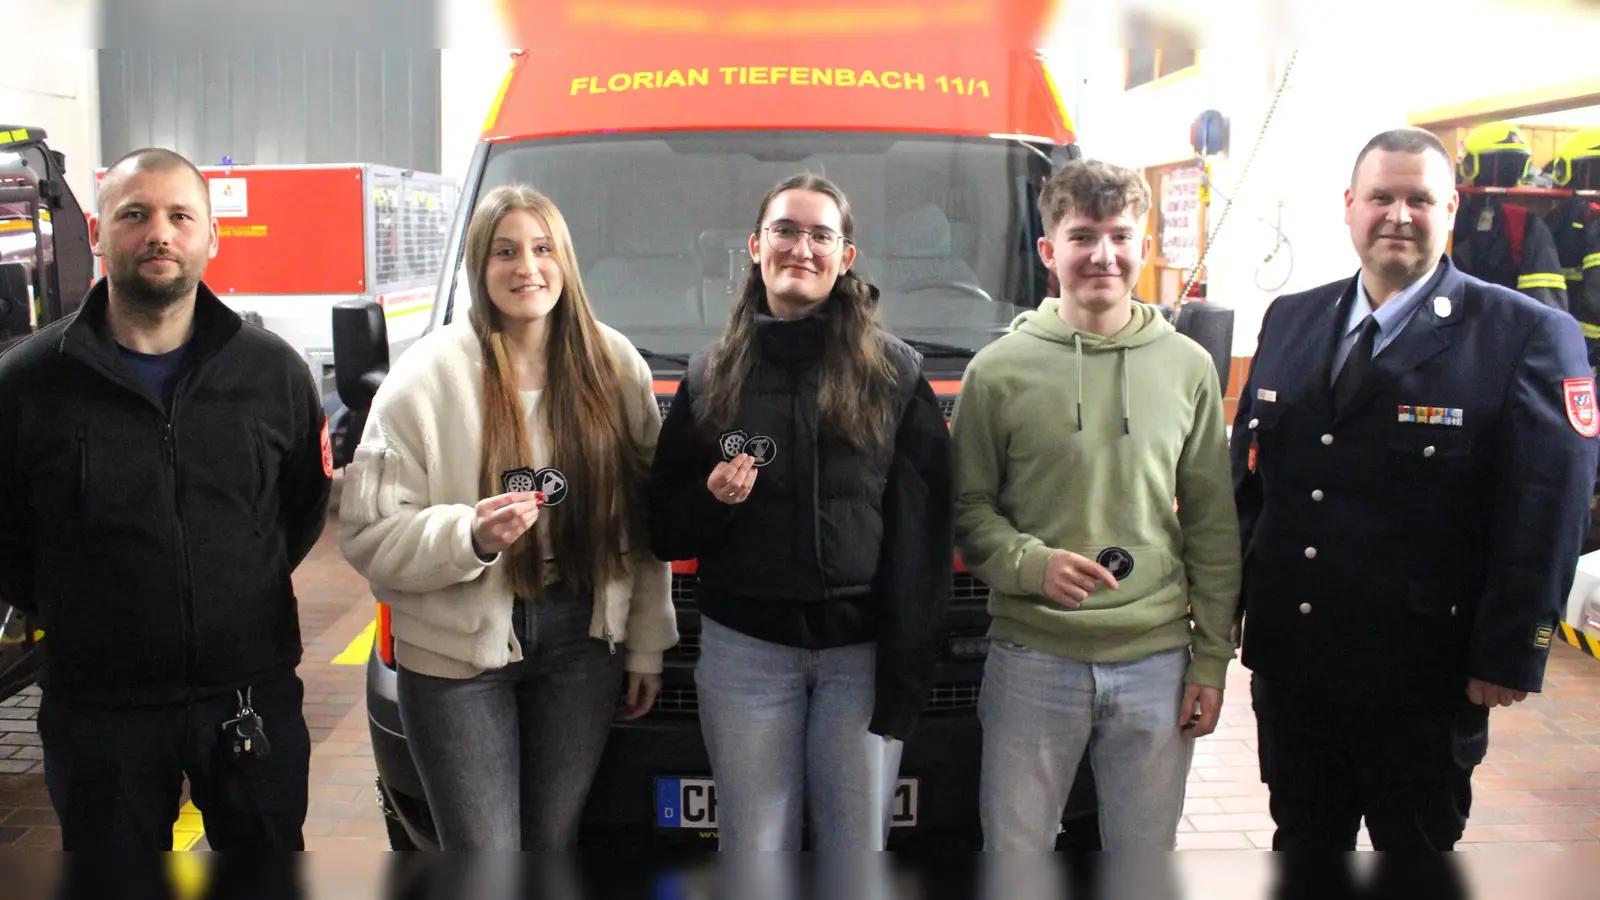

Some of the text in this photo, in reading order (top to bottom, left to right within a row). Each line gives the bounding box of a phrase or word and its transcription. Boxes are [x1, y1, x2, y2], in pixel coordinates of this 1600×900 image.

[569, 66, 990, 98] FLORIAN TIEFENBACH 11/1
